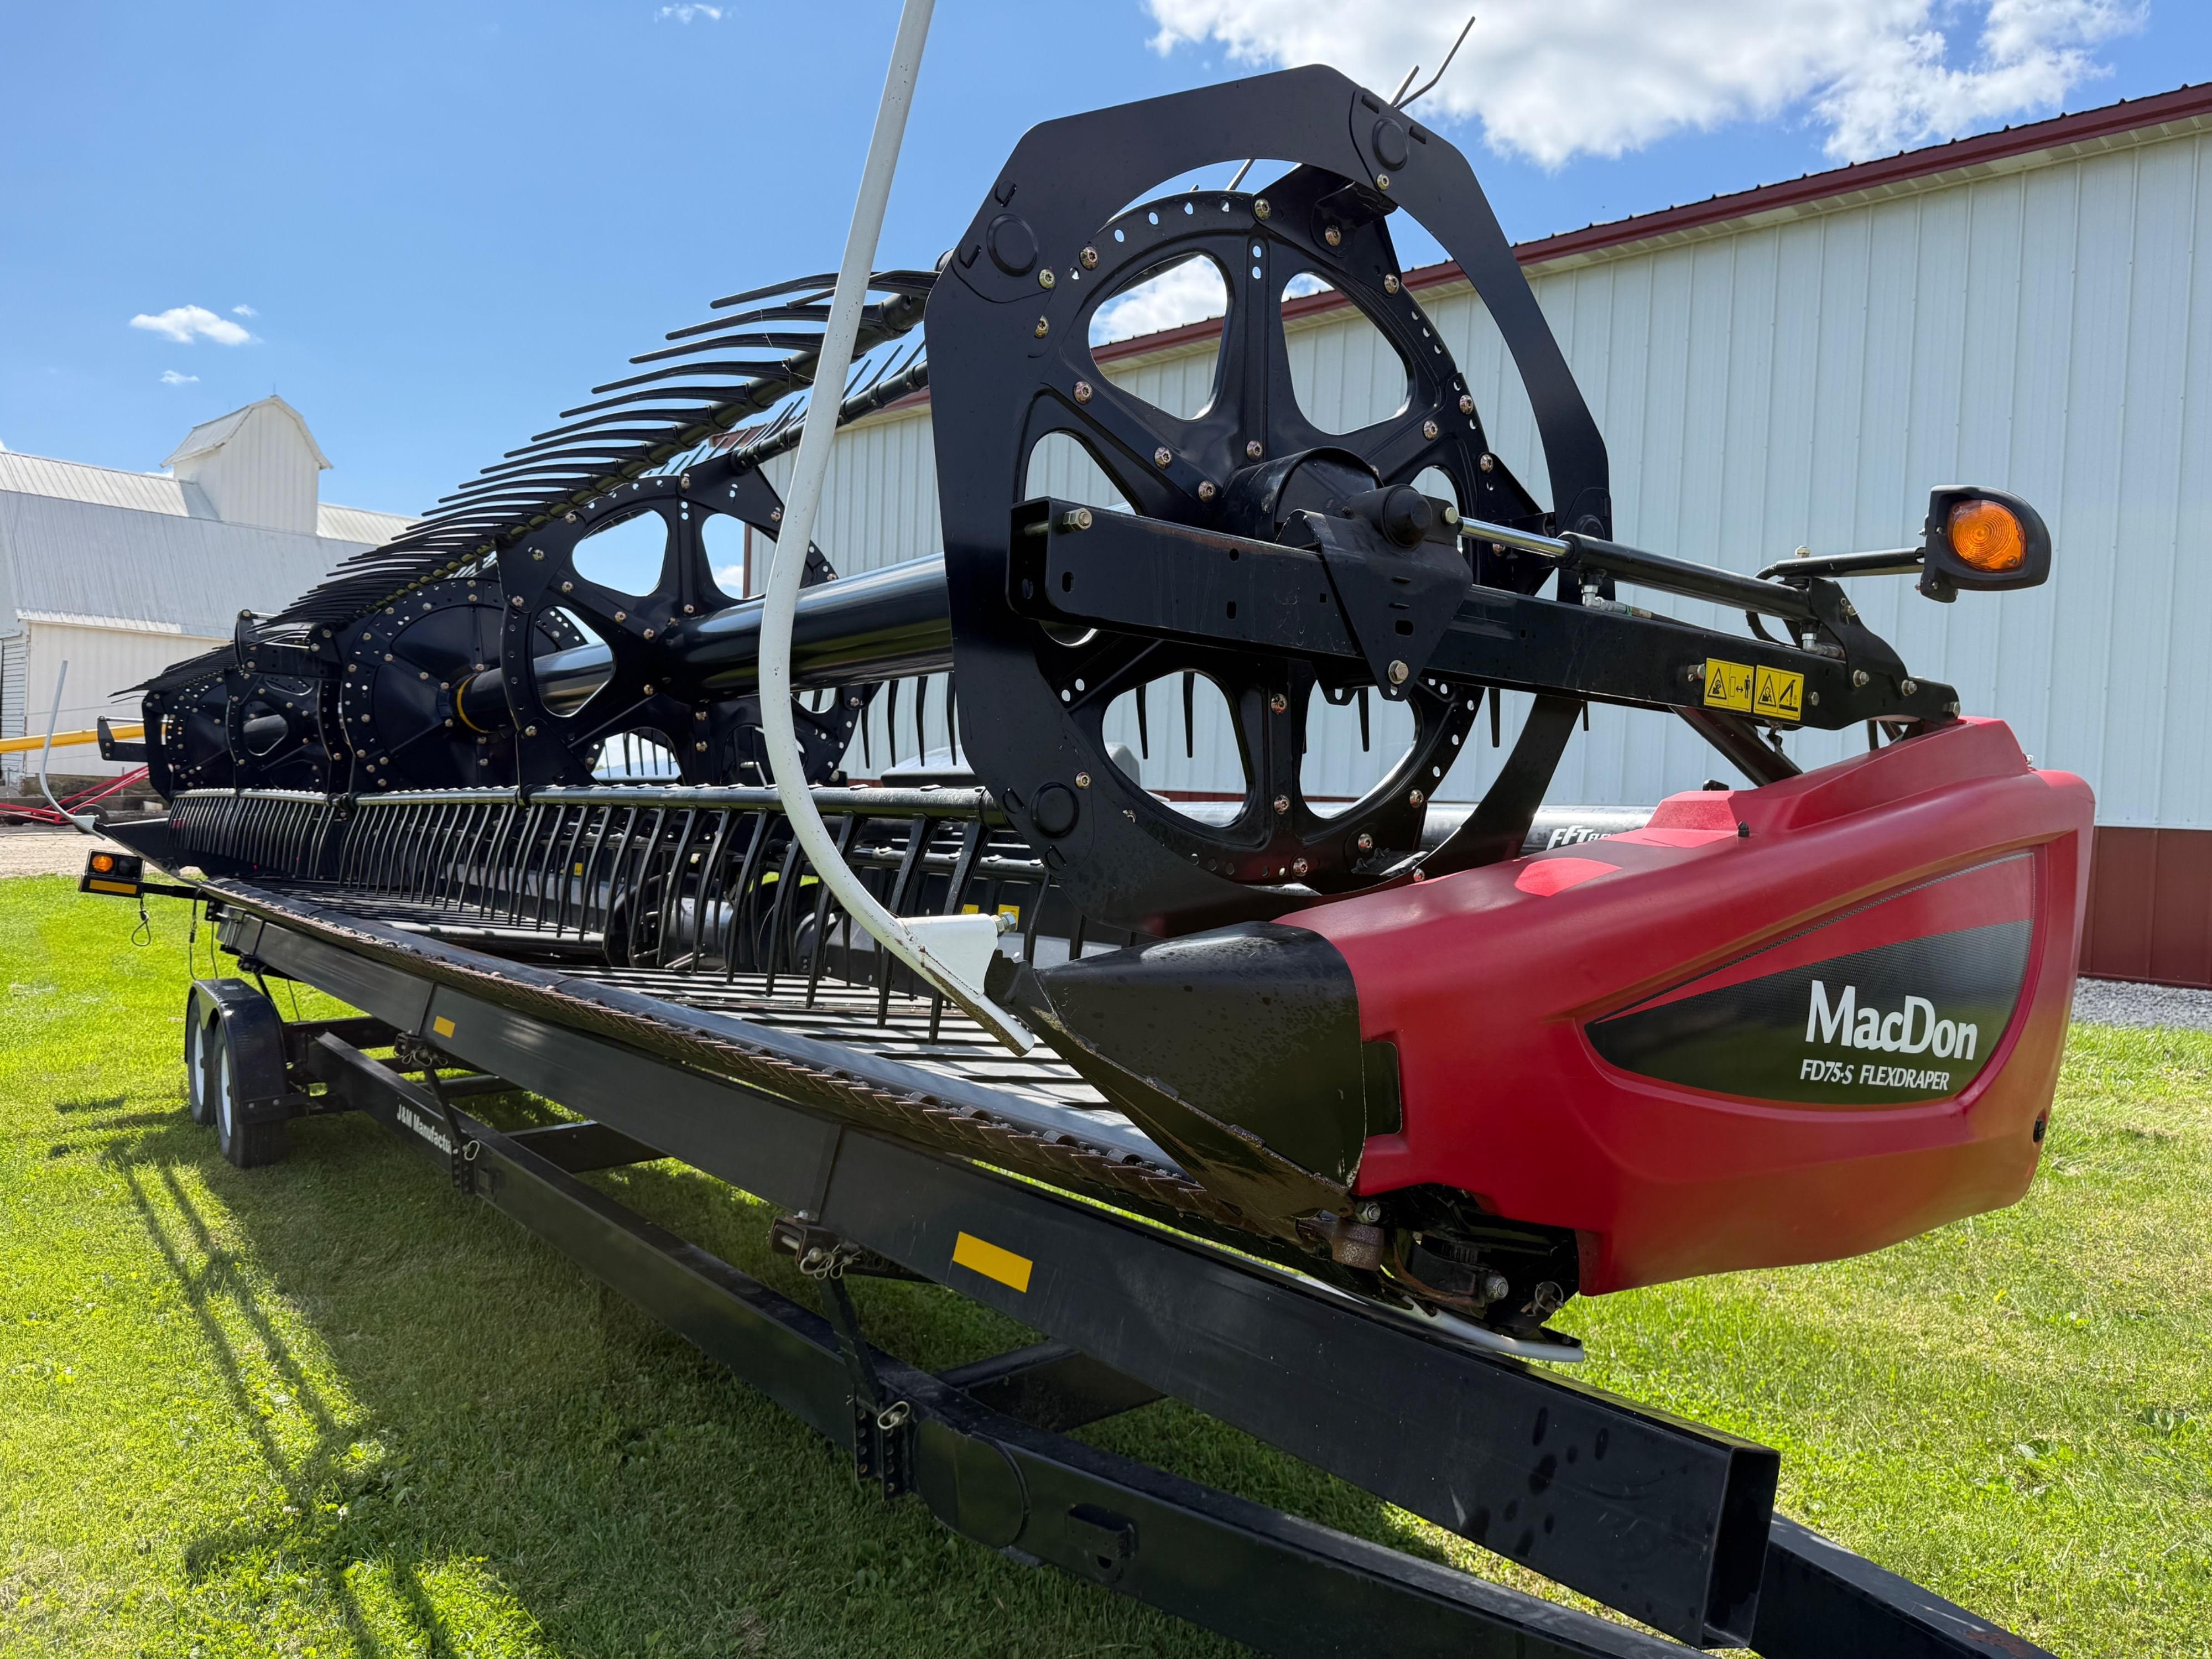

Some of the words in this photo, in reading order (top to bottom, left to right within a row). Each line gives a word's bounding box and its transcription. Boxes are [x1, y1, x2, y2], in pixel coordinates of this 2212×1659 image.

[1805, 980, 1978, 1060] MacDon
[1800, 1059, 1854, 1085] FD75-S
[1859, 1064, 1950, 1090] FLEXDRAPER
[397, 1104, 413, 1128] J&M
